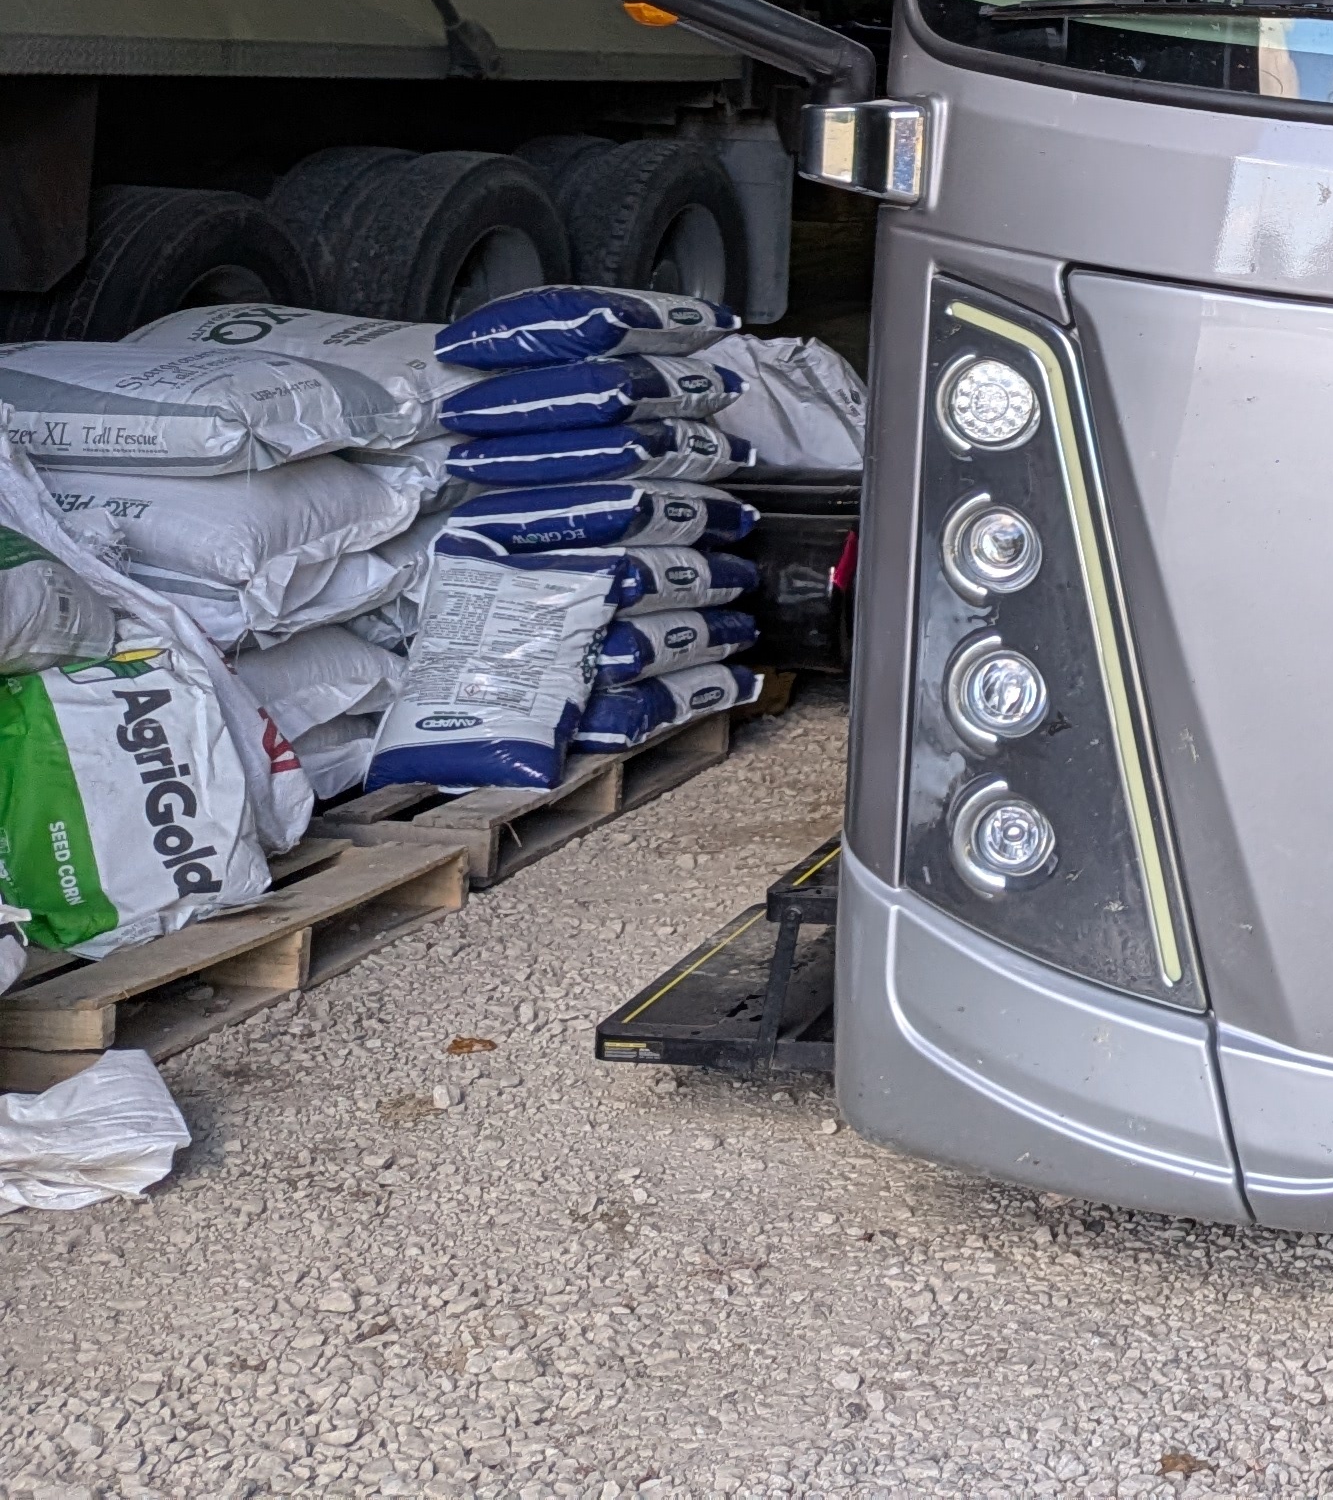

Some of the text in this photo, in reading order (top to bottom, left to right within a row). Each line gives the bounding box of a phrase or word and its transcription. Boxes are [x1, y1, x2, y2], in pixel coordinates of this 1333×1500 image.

[41, 421, 71, 446] XL
[82, 426, 111, 446] Tall
[115, 427, 158, 446] Fescue
[511, 528, 586, 545] EC GROW
[421, 717, 477, 729] AWARD
[111, 688, 223, 900] AgriGold
[49, 821, 84, 907] SEED CORN
